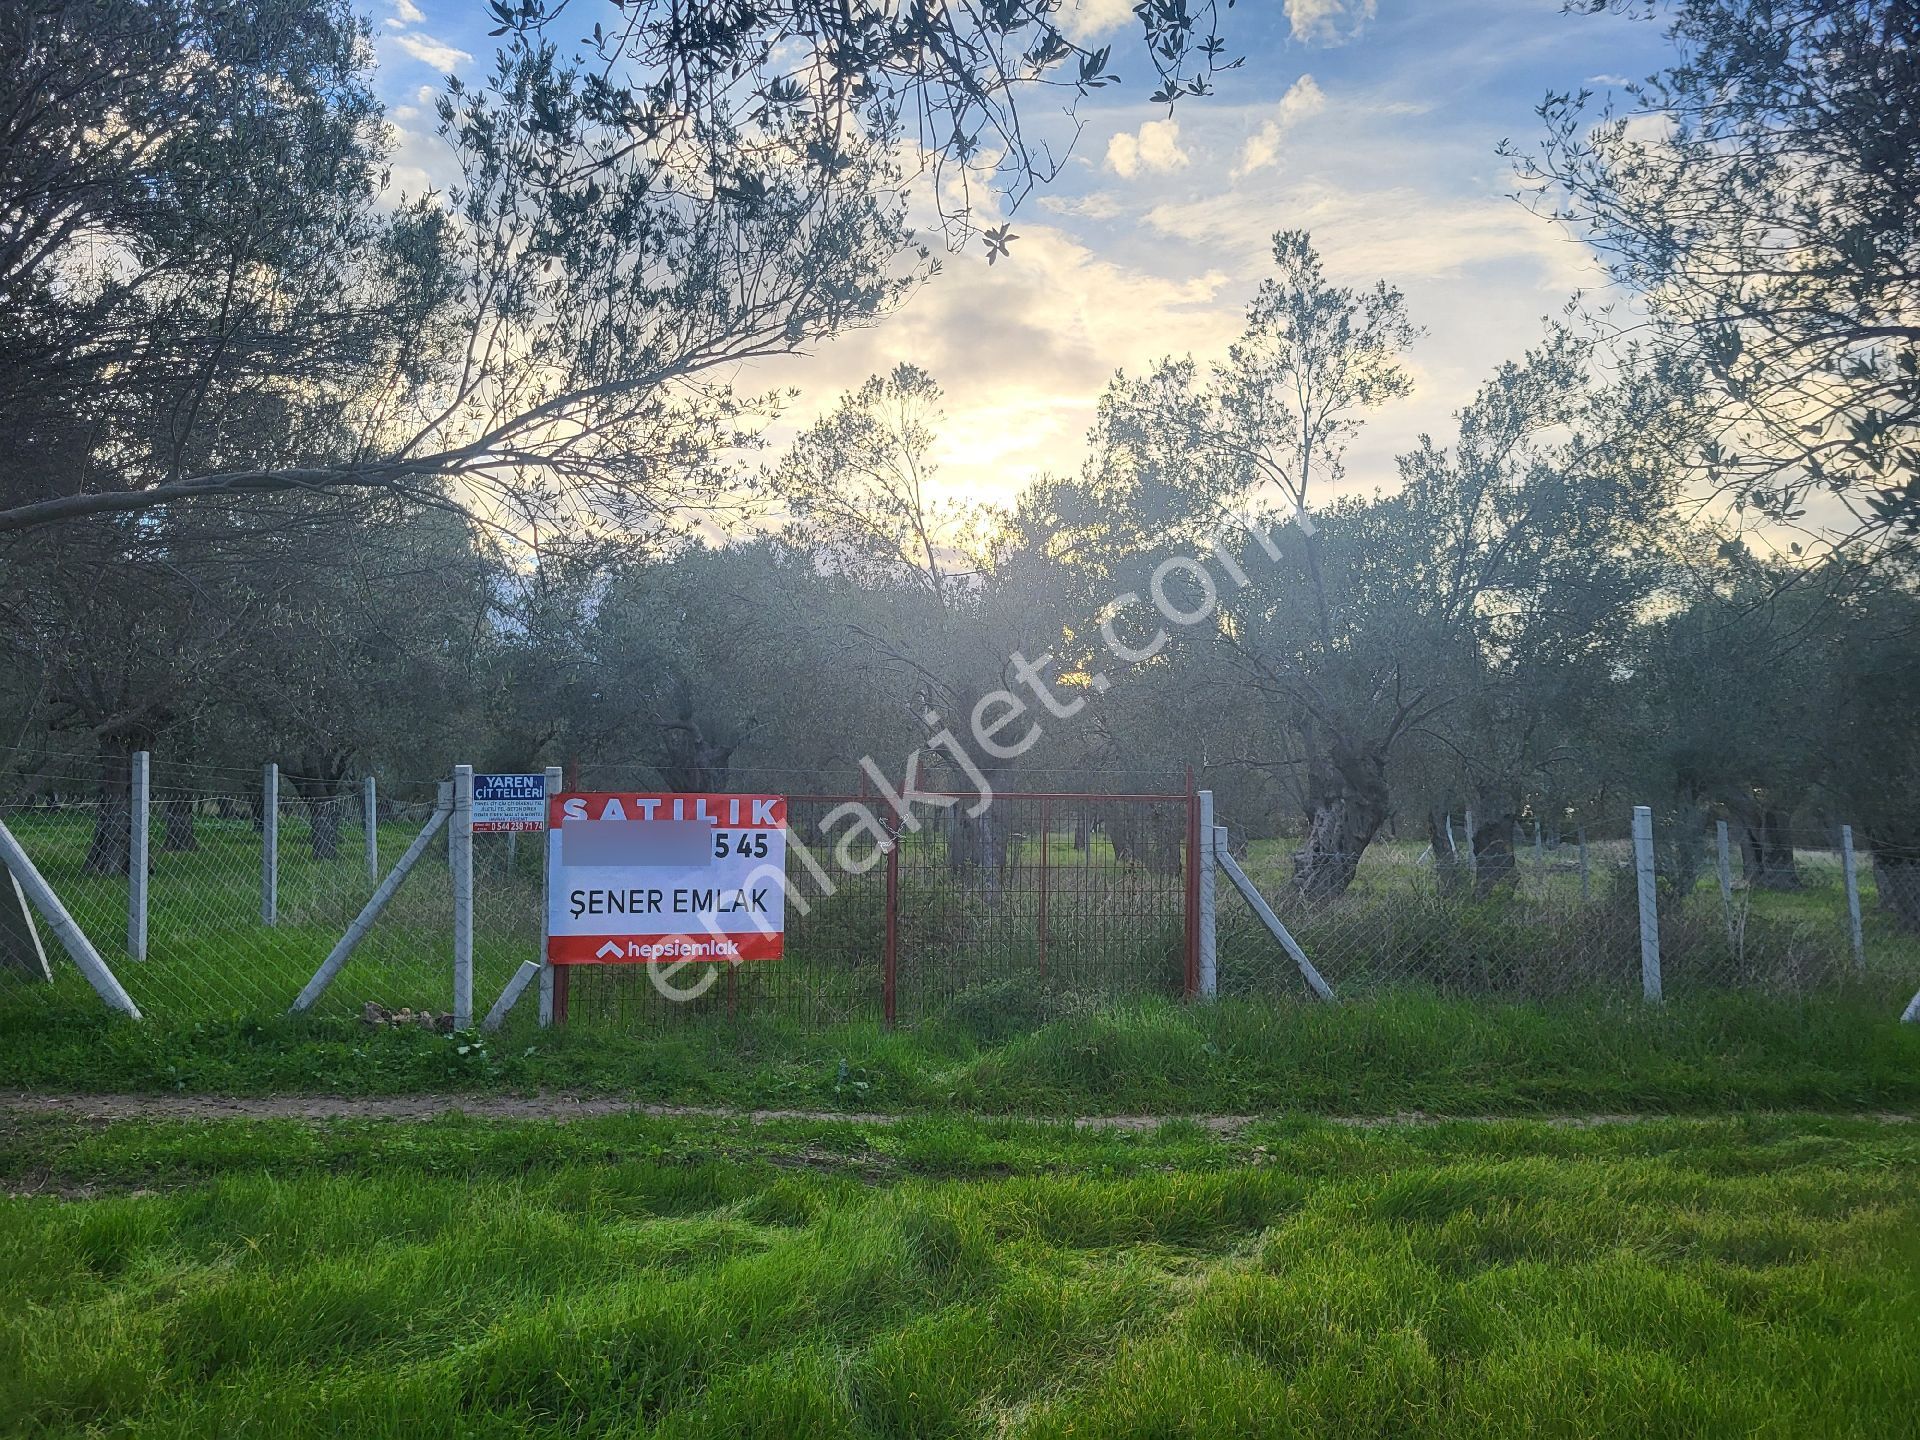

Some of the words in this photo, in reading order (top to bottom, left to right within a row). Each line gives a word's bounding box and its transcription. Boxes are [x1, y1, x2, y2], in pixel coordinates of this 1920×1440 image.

[475, 785, 494, 800] ÇİT
[495, 785, 543, 799] TELLERİ
[486, 776, 534, 788] YAREN
[562, 798, 778, 825] SATILIK
[491, 822, 496, 831] 0
[736, 833, 769, 859] 45
[569, 889, 664, 920] ŞENER
[673, 888, 768, 913] EMLAK
[627, 939, 739, 960] hepsiemlak
